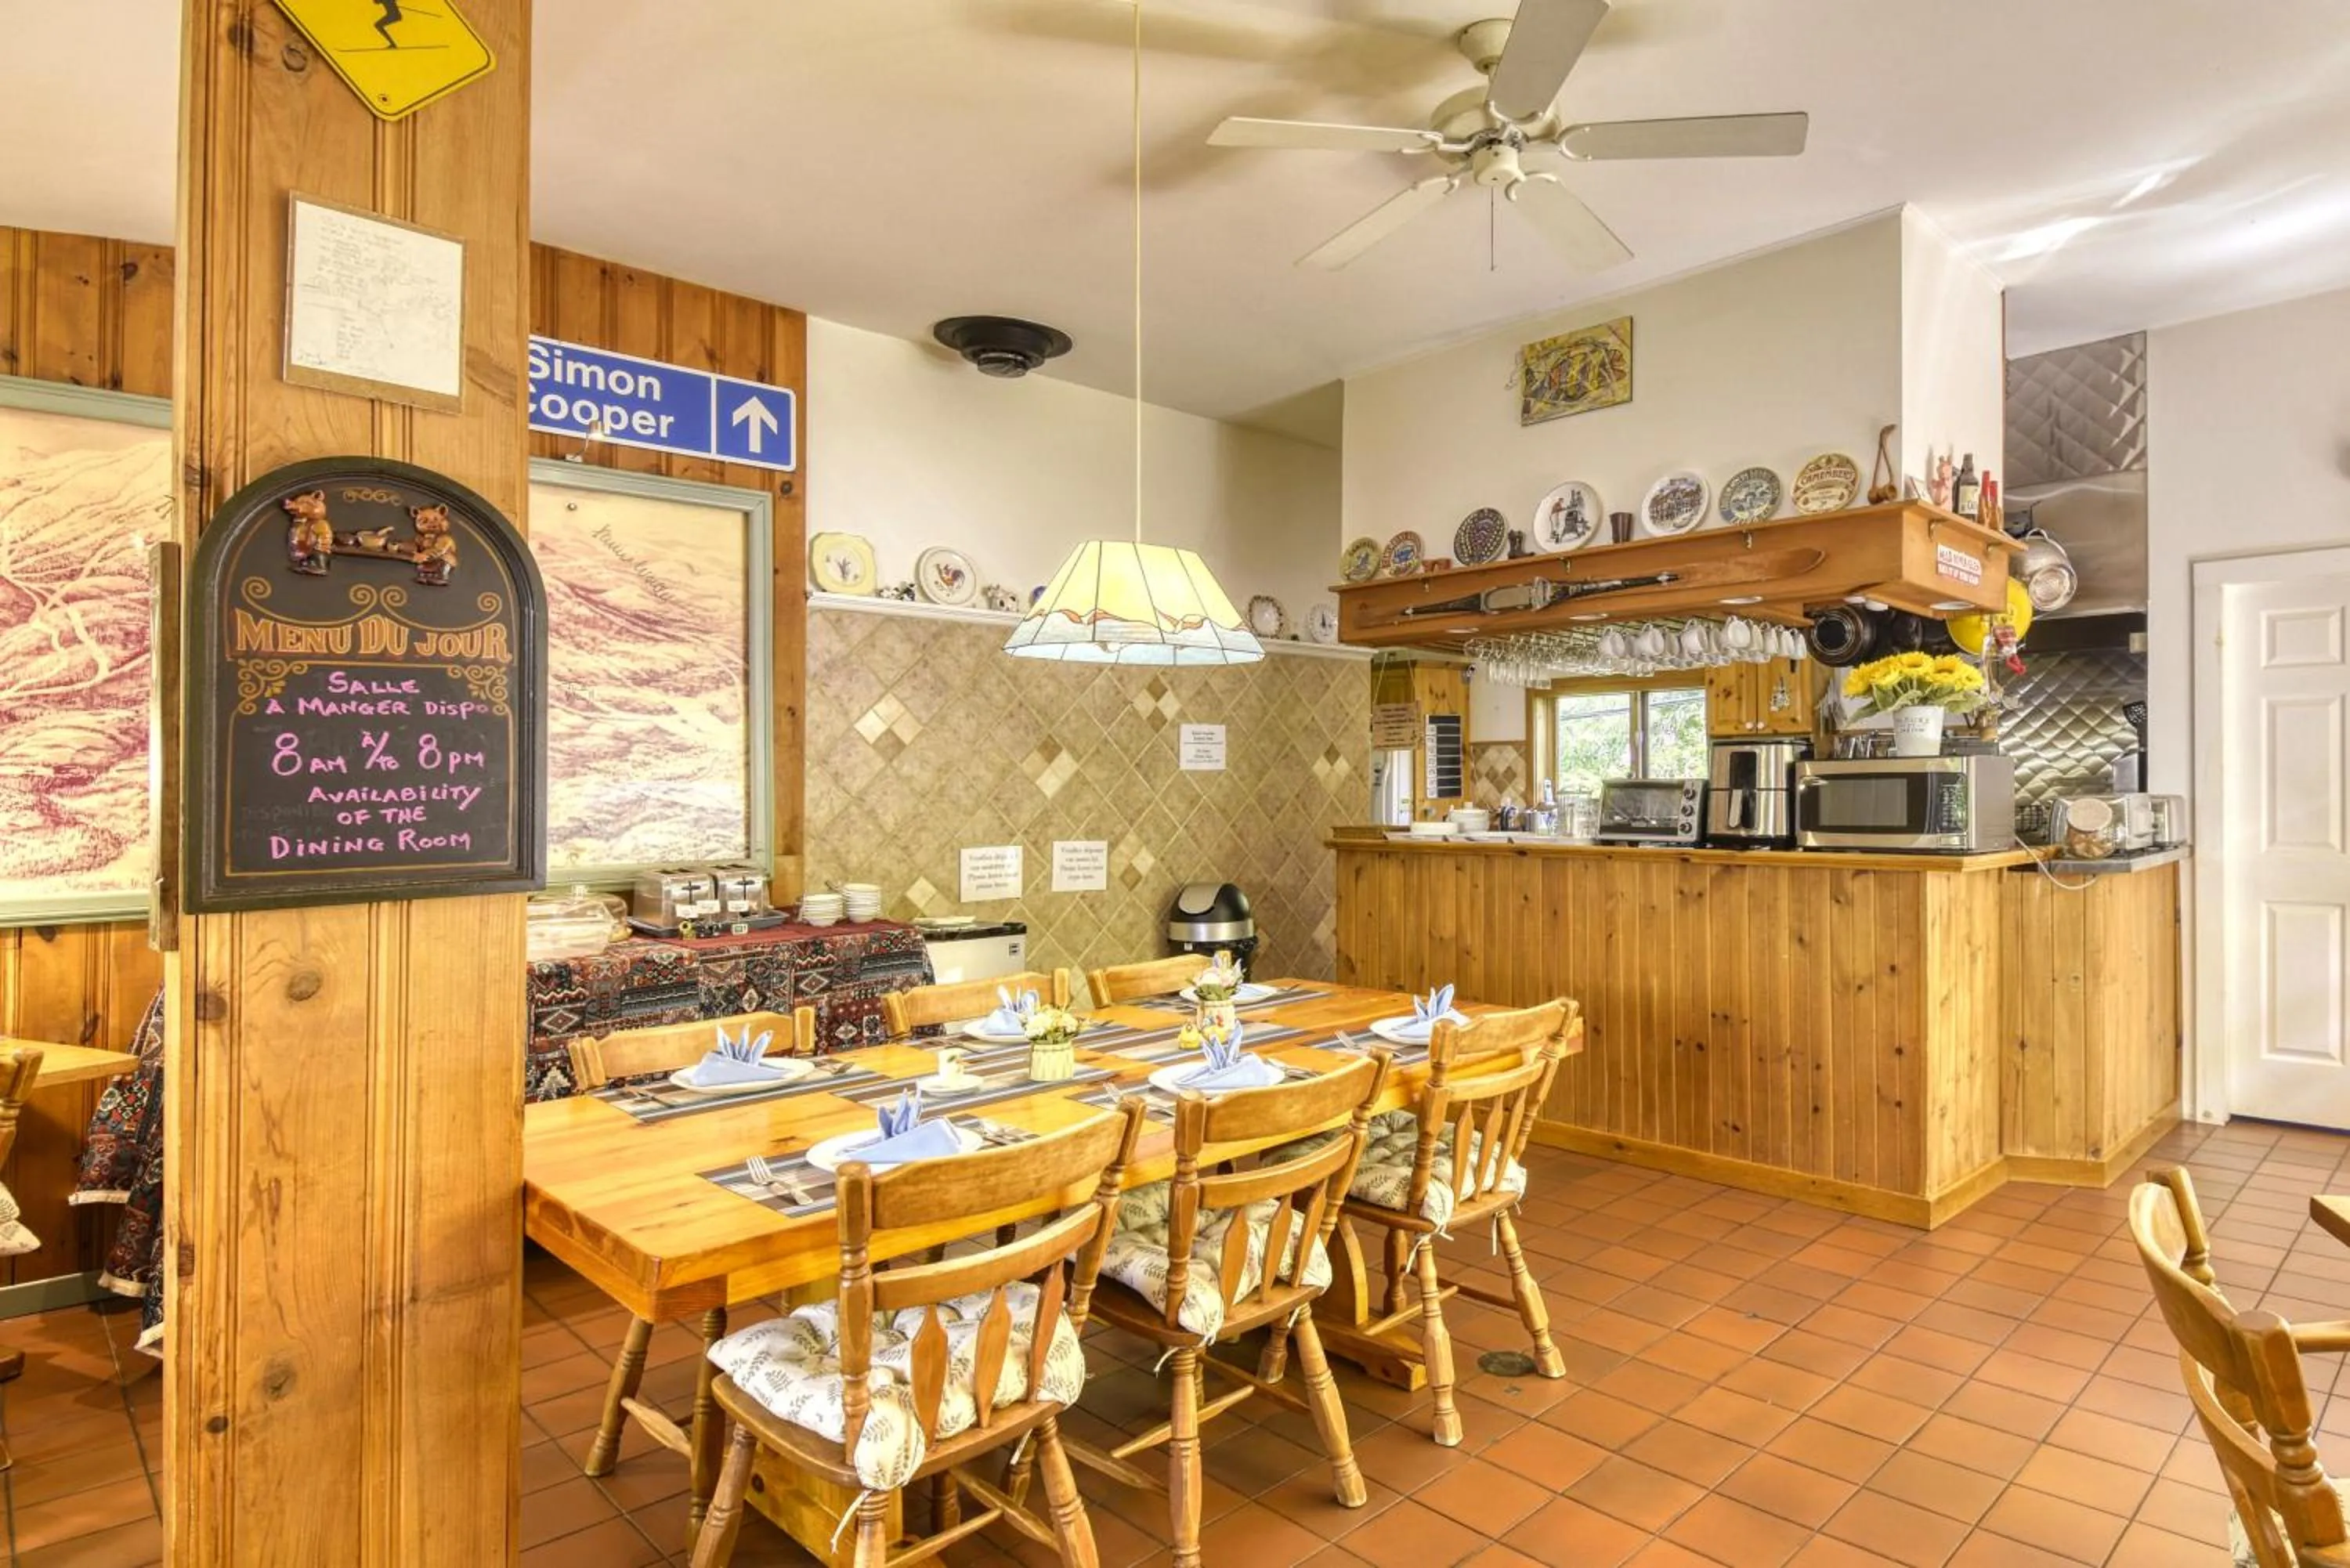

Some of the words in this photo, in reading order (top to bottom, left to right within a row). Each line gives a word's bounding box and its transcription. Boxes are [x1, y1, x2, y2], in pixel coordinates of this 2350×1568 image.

[529, 342, 661, 401] Simon
[234, 608, 352, 653] MENU
[358, 612, 409, 656] DU
[414, 622, 512, 663] JOUR
[327, 670, 420, 694] SALLE
[298, 696, 411, 717] MANGER
[272, 732, 303, 776] 8
[309, 754, 348, 774] AM
[418, 733, 442, 769] 8
[337, 807, 372, 825] OF
[379, 805, 427, 825] THE
[397, 828, 472, 851] ROOM
